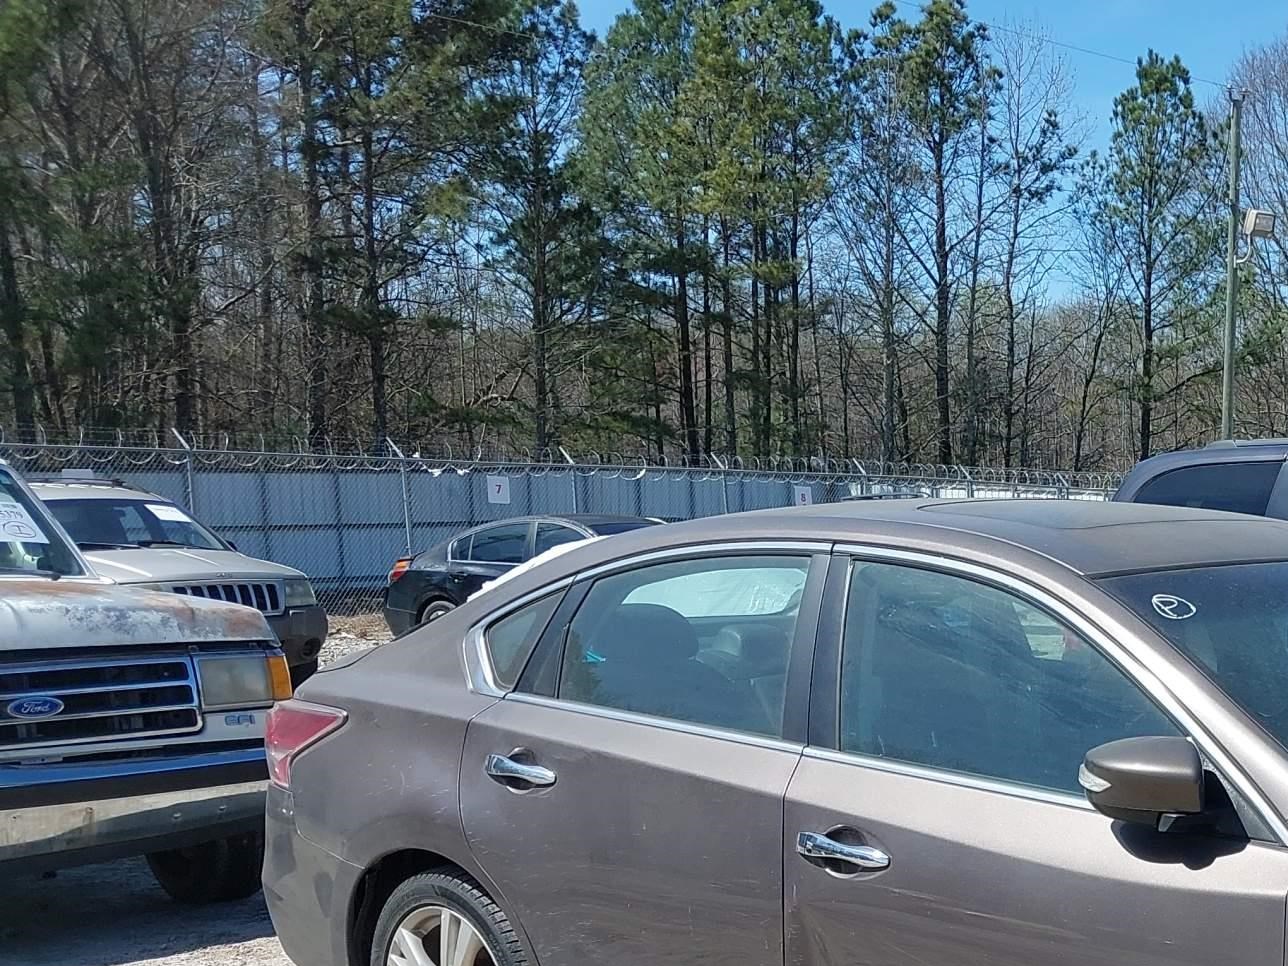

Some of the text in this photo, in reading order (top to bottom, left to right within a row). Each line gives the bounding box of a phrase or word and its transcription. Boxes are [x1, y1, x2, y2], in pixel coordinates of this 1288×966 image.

[495, 484, 502, 494] 7
[800, 493, 807, 502] 8
[21, 701, 50, 714] Ford
